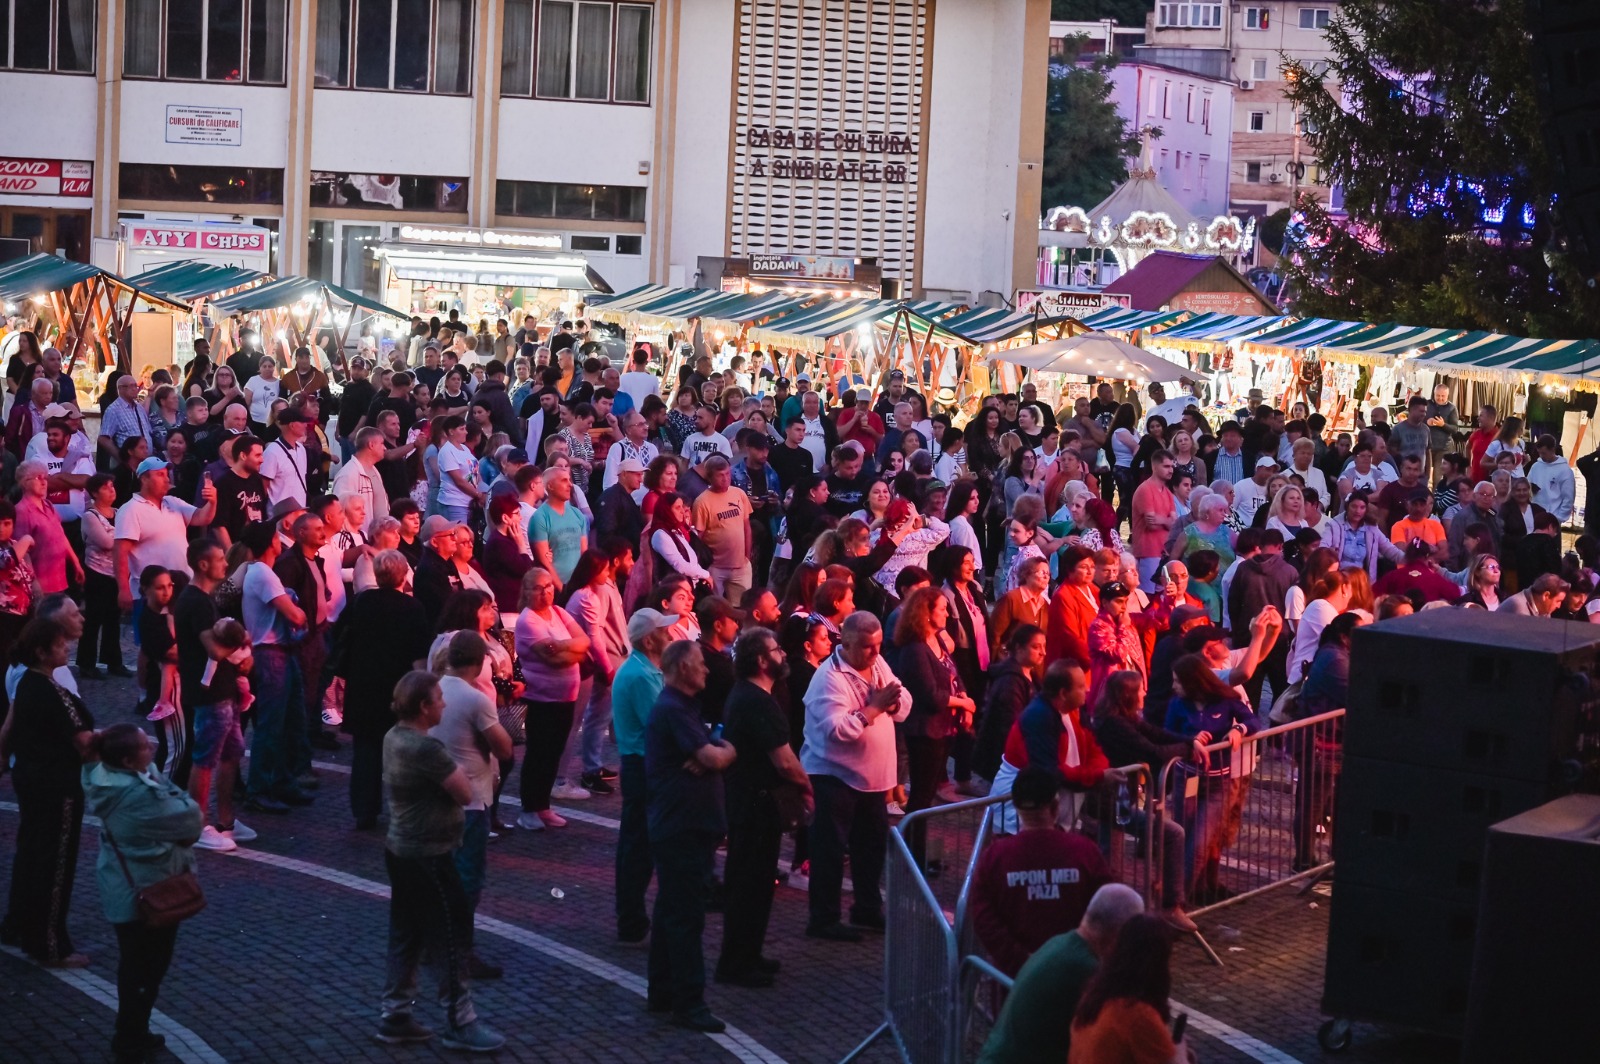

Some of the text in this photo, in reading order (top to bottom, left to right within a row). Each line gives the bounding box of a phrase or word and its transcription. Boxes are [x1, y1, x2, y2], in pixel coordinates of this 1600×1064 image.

[169, 117, 239, 128] CURSURI de CALIFICARE
[747, 128, 912, 153] CASA DE CULTURA
[752, 158, 907, 182] A SINDICATELOR
[62, 180, 90, 192] VLM
[140, 230, 260, 249] ATY CHIPS
[753, 261, 799, 271] DADAMI
[694, 442, 718, 452] GAMER
[237, 490, 262, 510] Fender
[717, 508, 740, 521] PUMA
[1007, 868, 1080, 887] IPPON MED
[1027, 884, 1060, 900] PAZA
